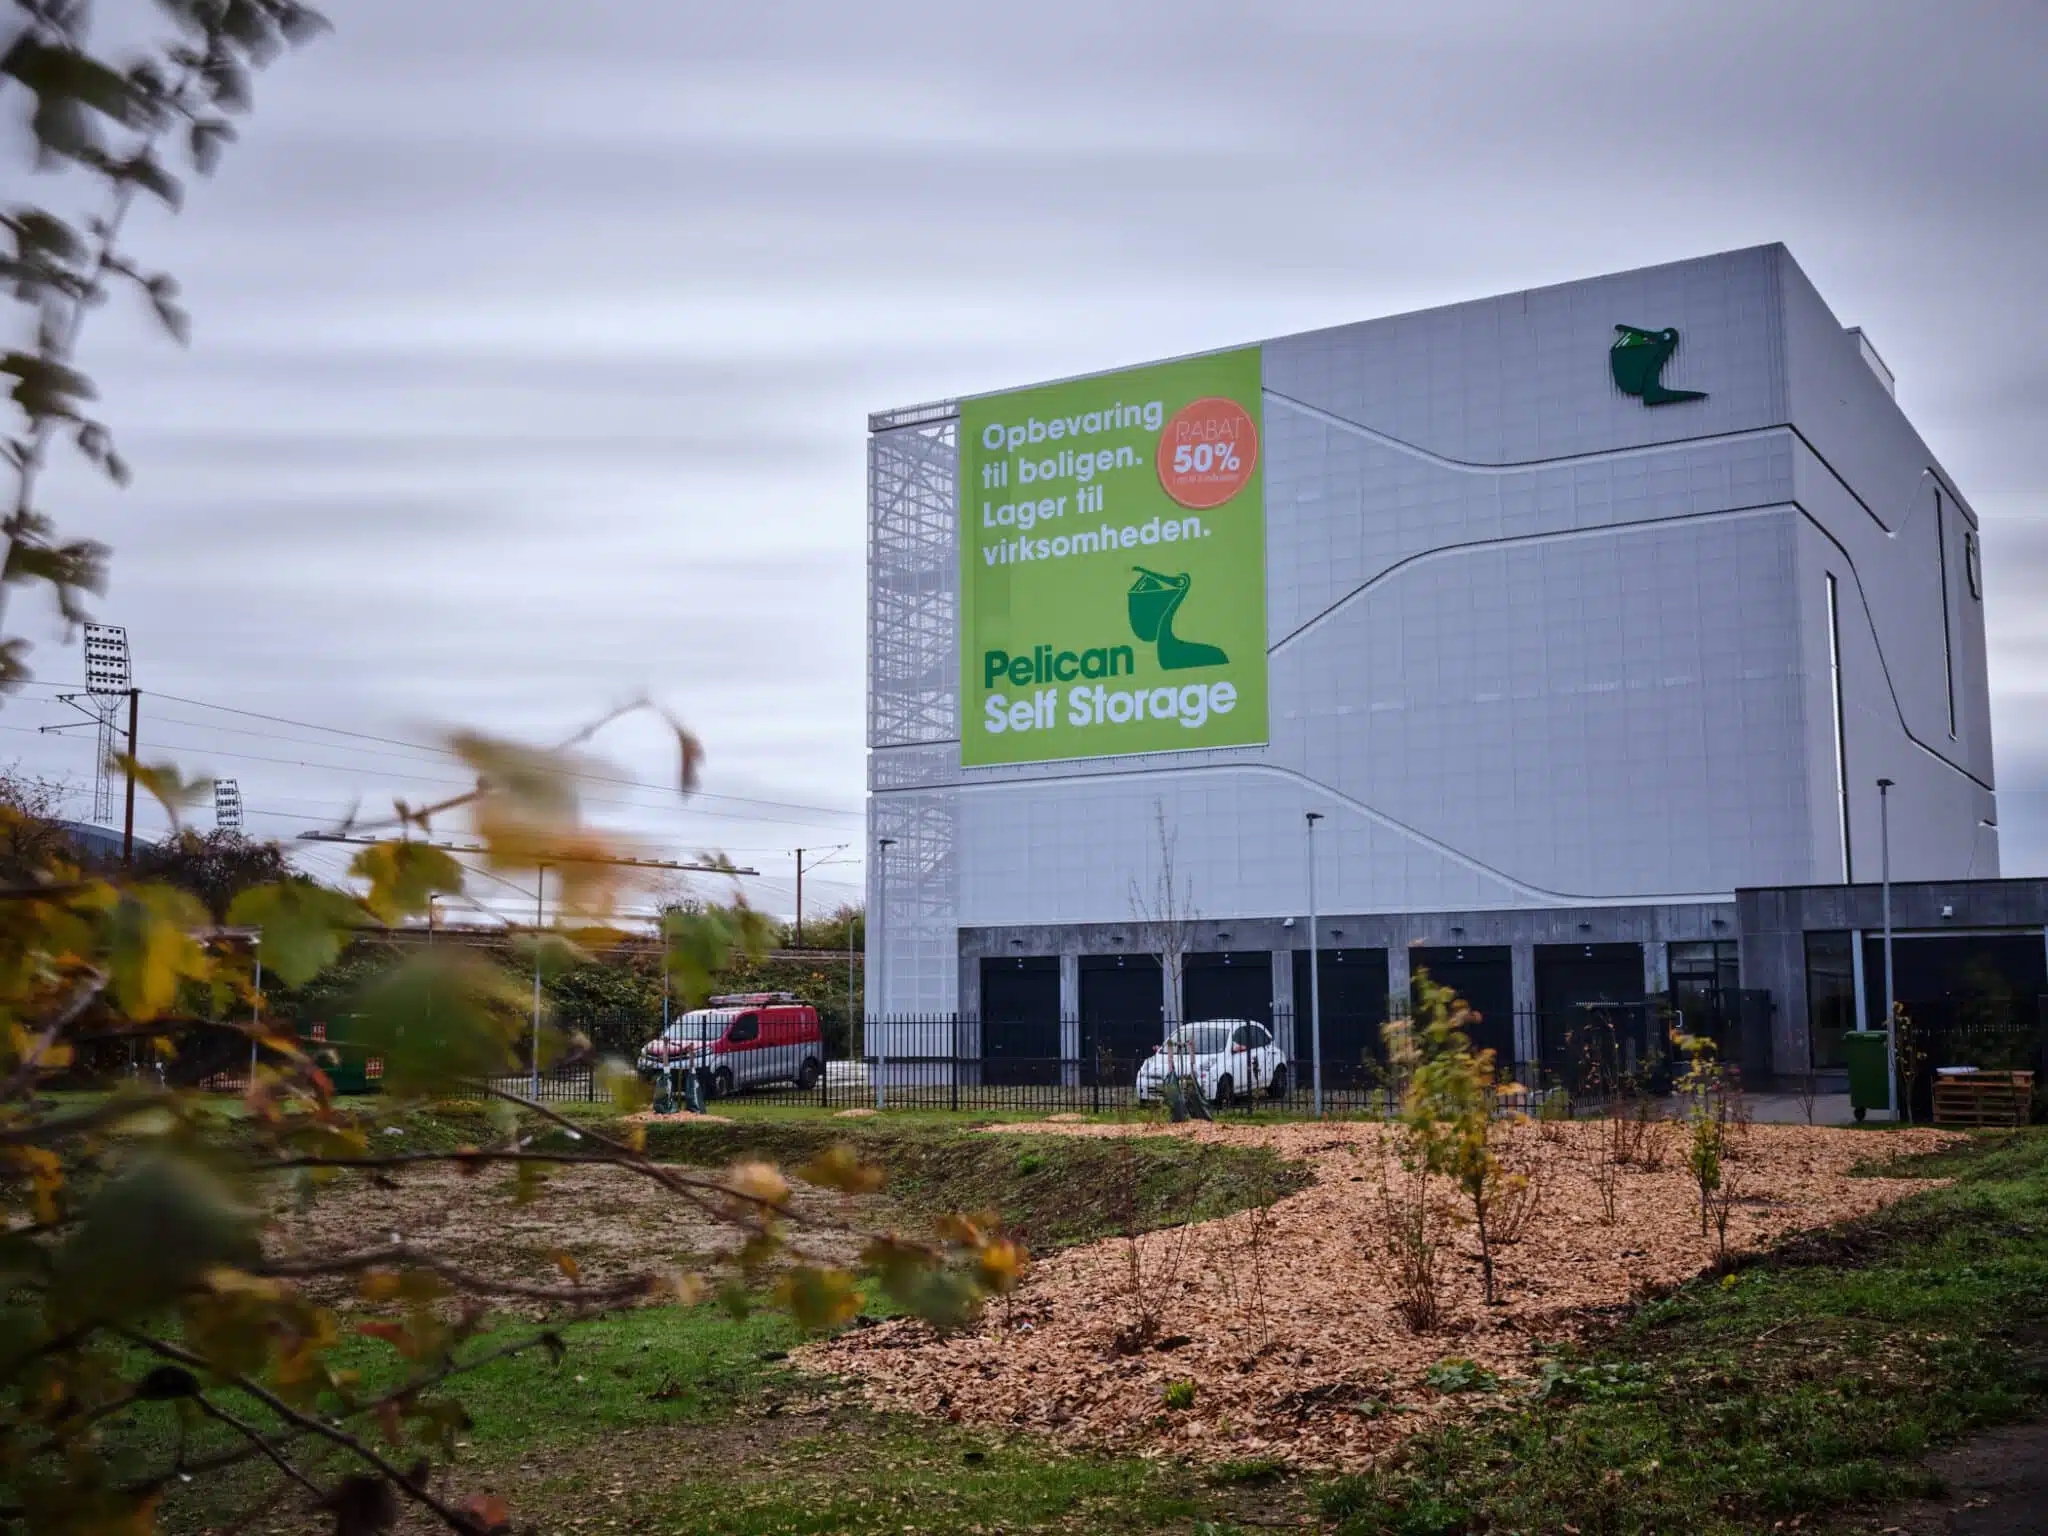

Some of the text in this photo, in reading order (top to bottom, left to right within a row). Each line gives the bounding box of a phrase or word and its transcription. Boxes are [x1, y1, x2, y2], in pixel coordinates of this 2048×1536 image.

[982, 400, 1164, 452] Opbevaring
[1176, 416, 1245, 442] RABAT
[982, 445, 1143, 488] til boligen.
[1173, 441, 1241, 473] 50%
[983, 484, 1104, 530] Lager til
[982, 516, 1212, 566] virksomheden.
[984, 644, 1134, 689] Pelican
[984, 681, 1238, 733] Self Storage
